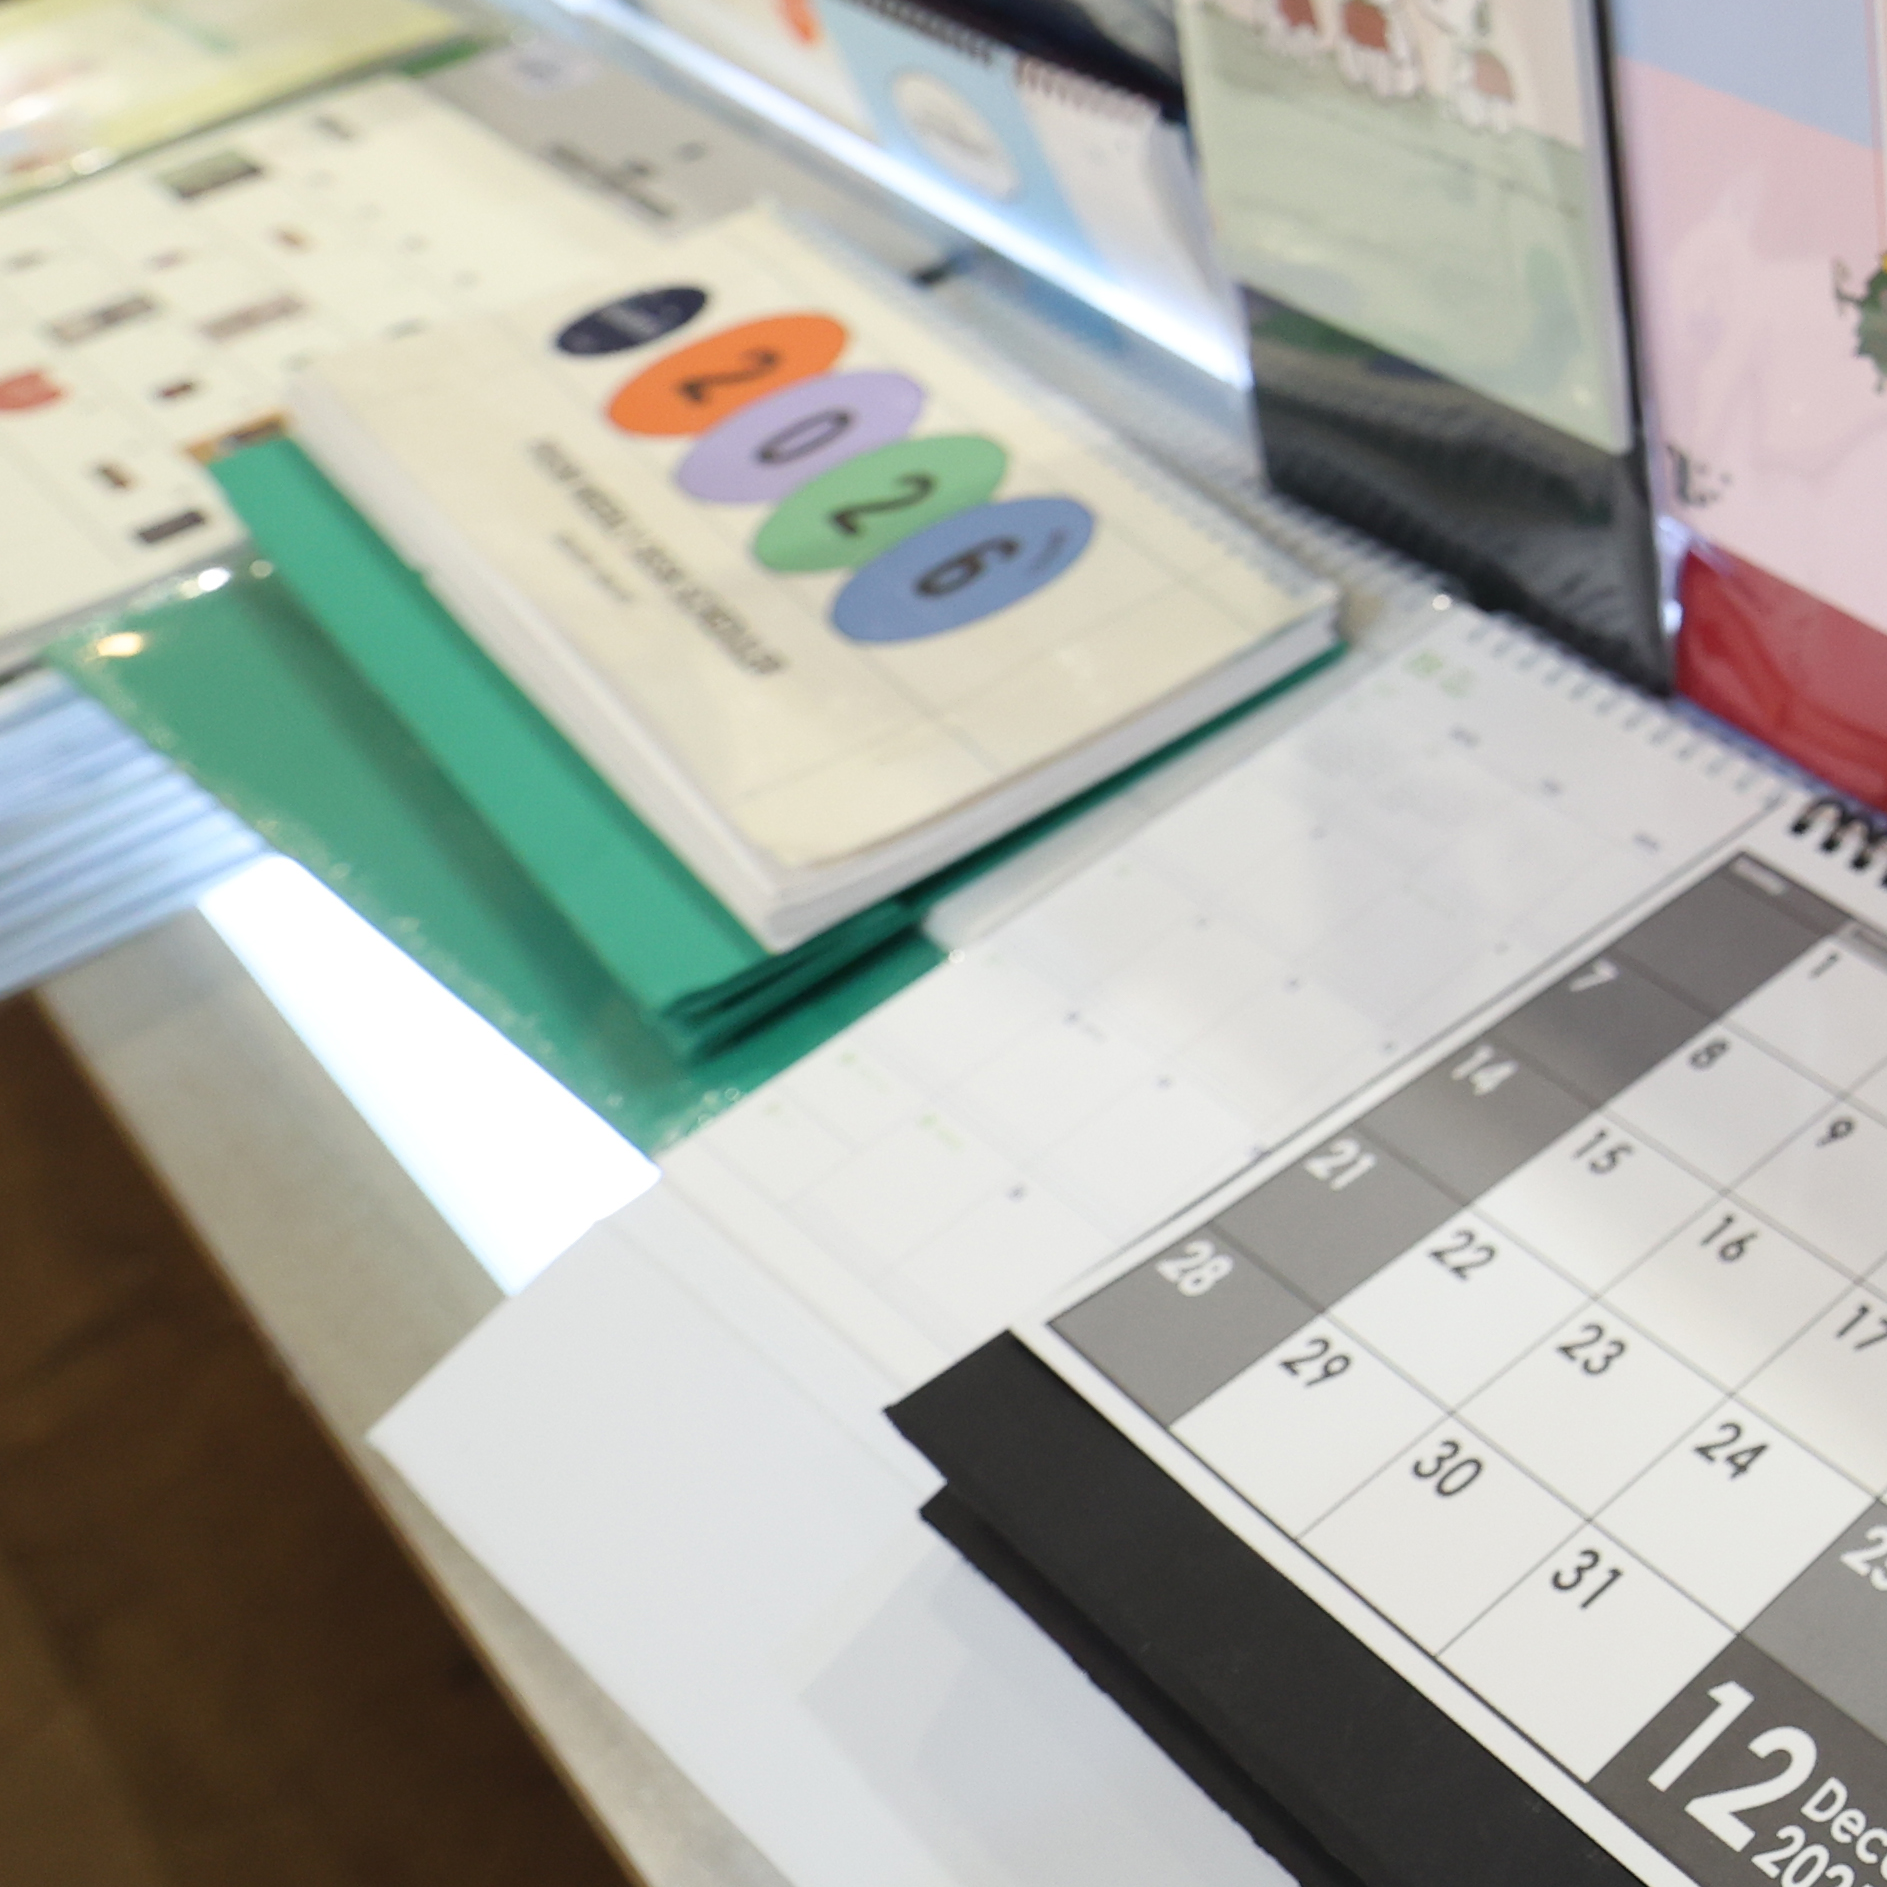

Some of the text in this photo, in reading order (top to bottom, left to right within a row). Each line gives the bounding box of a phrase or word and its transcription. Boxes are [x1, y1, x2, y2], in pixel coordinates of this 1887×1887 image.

[1572, 961, 1617, 990] 7
[1688, 1039, 1729, 1071] 8
[1815, 1116, 1855, 1148] 9
[1809, 952, 1840, 981] 1
[1453, 1047, 1515, 1094] 14
[1576, 1128, 1633, 1174] 15
[1702, 1214, 1758, 1262] 16
[1306, 1139, 1375, 1189] 21
[1429, 1229, 1497, 1280] 22
[1556, 1323, 1627, 1376] 23
[1694, 1421, 1769, 1479] 24
[1157, 1240, 1623, 1609] 28 29 30 31
[1647, 1681, 1818, 1852] 12
[1751, 1825, 1872, 1887] 202
